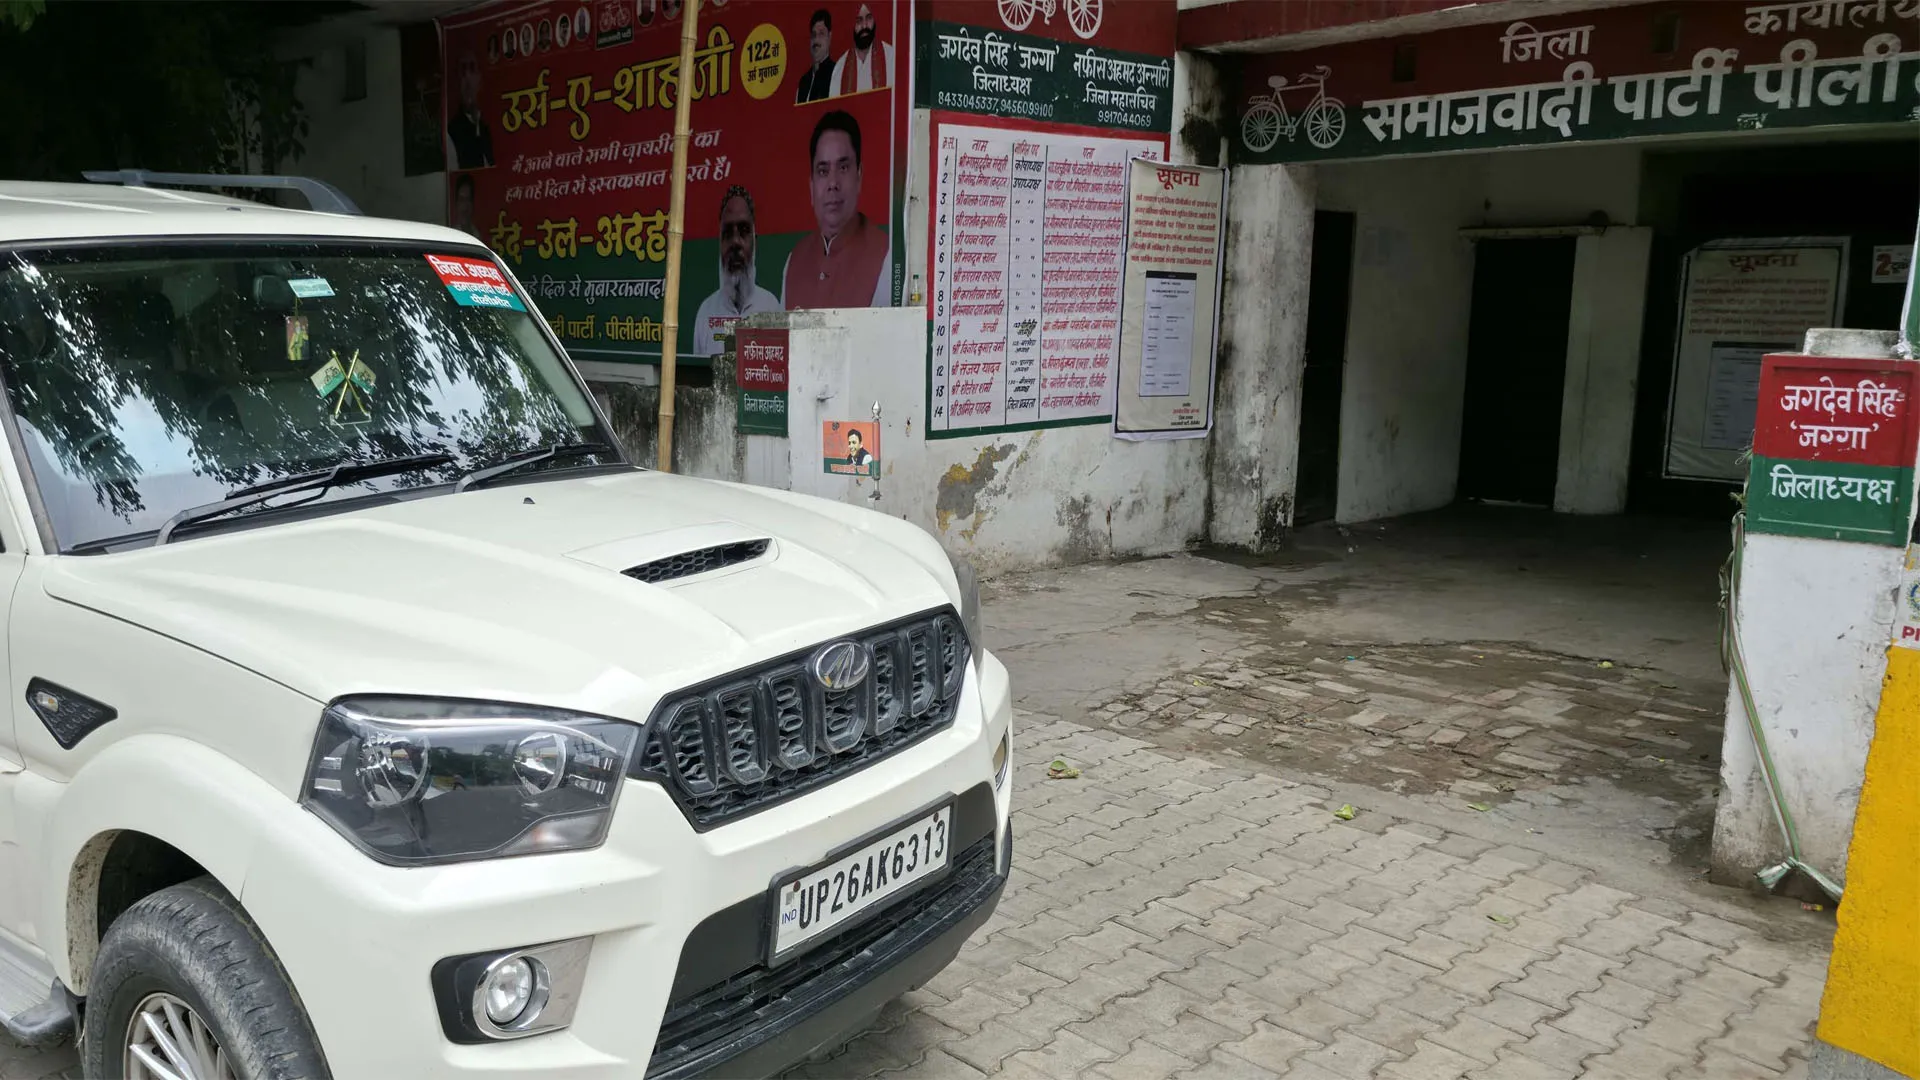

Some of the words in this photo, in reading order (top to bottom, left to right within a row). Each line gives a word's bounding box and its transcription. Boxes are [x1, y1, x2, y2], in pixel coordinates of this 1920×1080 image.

[747, 40, 771, 62] 122
[938, 27, 981, 64] जगदेव
[984, 31, 1011, 72] सिंह
[1500, 21, 1595, 63] जिला
[972, 65, 1032, 96] जिलाध्यक्ष
[1107, 57, 1136, 87] अहमद
[1136, 58, 1171, 89] अन्सारी
[1085, 81, 1111, 107] जिला
[1111, 86, 1157, 112] महासचिव
[1362, 61, 1601, 143] समाजवादी
[1607, 47, 1740, 121] पार्टी
[1743, 32, 1920, 110] पीली
[1097, 110, 1152, 127] 9917044069
[512, 154, 524, 172] में
[525, 151, 552, 174] आने
[554, 146, 583, 167] वाले
[585, 141, 620, 165] सभी
[695, 129, 722, 149] का
[971, 139, 989, 153] नाम
[944, 155, 949, 166] 1
[505, 184, 523, 202] हम
[524, 180, 543, 201] तहे
[545, 178, 570, 200] दिल
[571, 175, 587, 195] से
[588, 169, 666, 195] इस्तकबाल
[942, 172, 948, 184] 2
[1013, 177, 1042, 191] उपाध्यक्ष
[1156, 168, 1200, 190] सूचना
[940, 193, 947, 206] 3
[939, 213, 947, 226] 4
[939, 234, 946, 246] 5
[429, 254, 467, 277] जिला
[938, 252, 945, 264] 6
[1728, 253, 1799, 272] सूचना
[1876, 254, 1892, 275] 2
[540, 274, 566, 298] दिल
[568, 273, 582, 298] से
[939, 271, 946, 282] 7
[938, 291, 944, 303] 8
[938, 305, 944, 317] 9
[567, 314, 595, 339] पार्टी
[605, 315, 663, 342] पीलीभीत
[937, 326, 945, 337] 10
[937, 345, 943, 357] 11
[744, 364, 770, 382] अन्सारी
[936, 366, 944, 377] 12
[960, 360, 981, 376] संजय
[982, 362, 1002, 377] यादव
[936, 386, 945, 398] 13
[1780, 376, 1855, 416] जगदेव
[1856, 379, 1898, 417] सिंह
[935, 406, 943, 418] 14
[1790, 421, 1879, 450] ‘जग्गा’
[1769, 463, 1895, 504] जिलाध्यक्ष
[799, 819, 945, 929] UP26AK6313
[782, 908, 797, 925] IND
